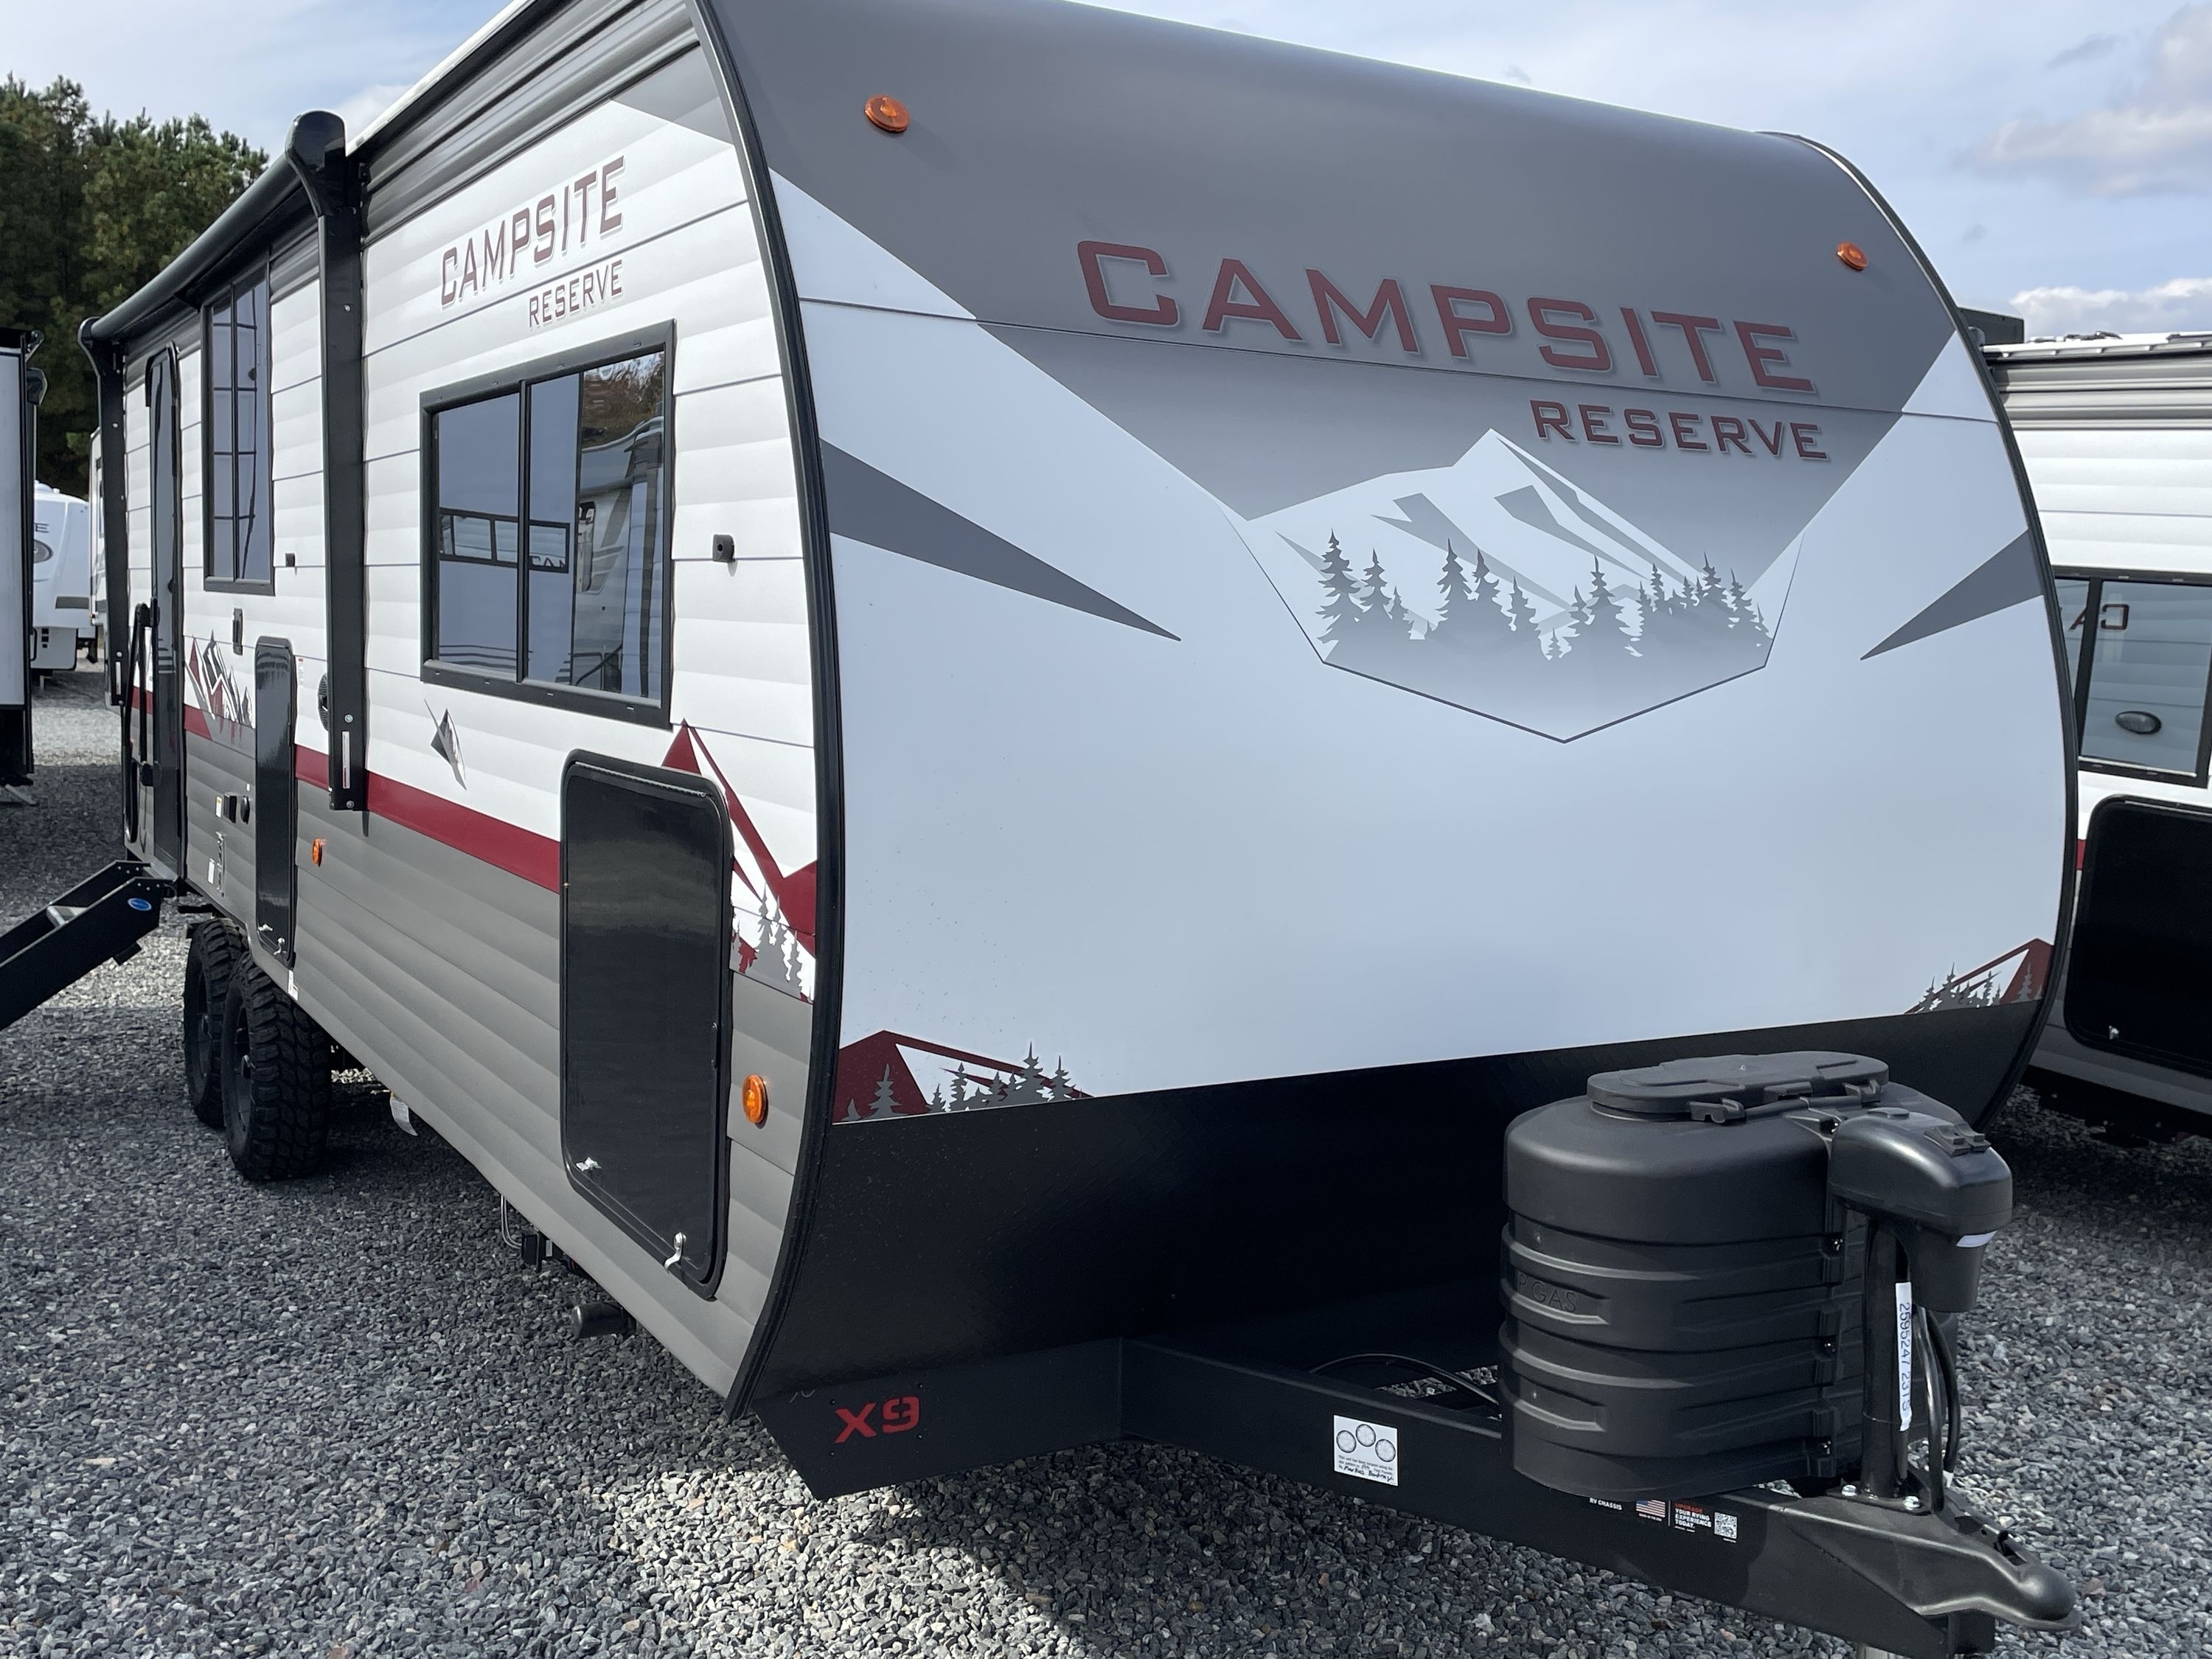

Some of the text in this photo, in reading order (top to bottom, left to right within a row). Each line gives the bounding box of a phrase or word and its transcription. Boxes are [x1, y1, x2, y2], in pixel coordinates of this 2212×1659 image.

[441, 154, 625, 306] CAMPSITE
[529, 259, 623, 328] RESERVE
[1077, 240, 1815, 392] CAMPSITE
[1529, 399, 1829, 460] RESERVE
[1531, 1281, 1576, 1312] GAS
[833, 1396, 920, 1444] X9
[1598, 1499, 1622, 1511] CHASSIS
[1675, 1508, 1691, 1517] YOUR
[1675, 1513, 1711, 1528] EXPERIENCE
